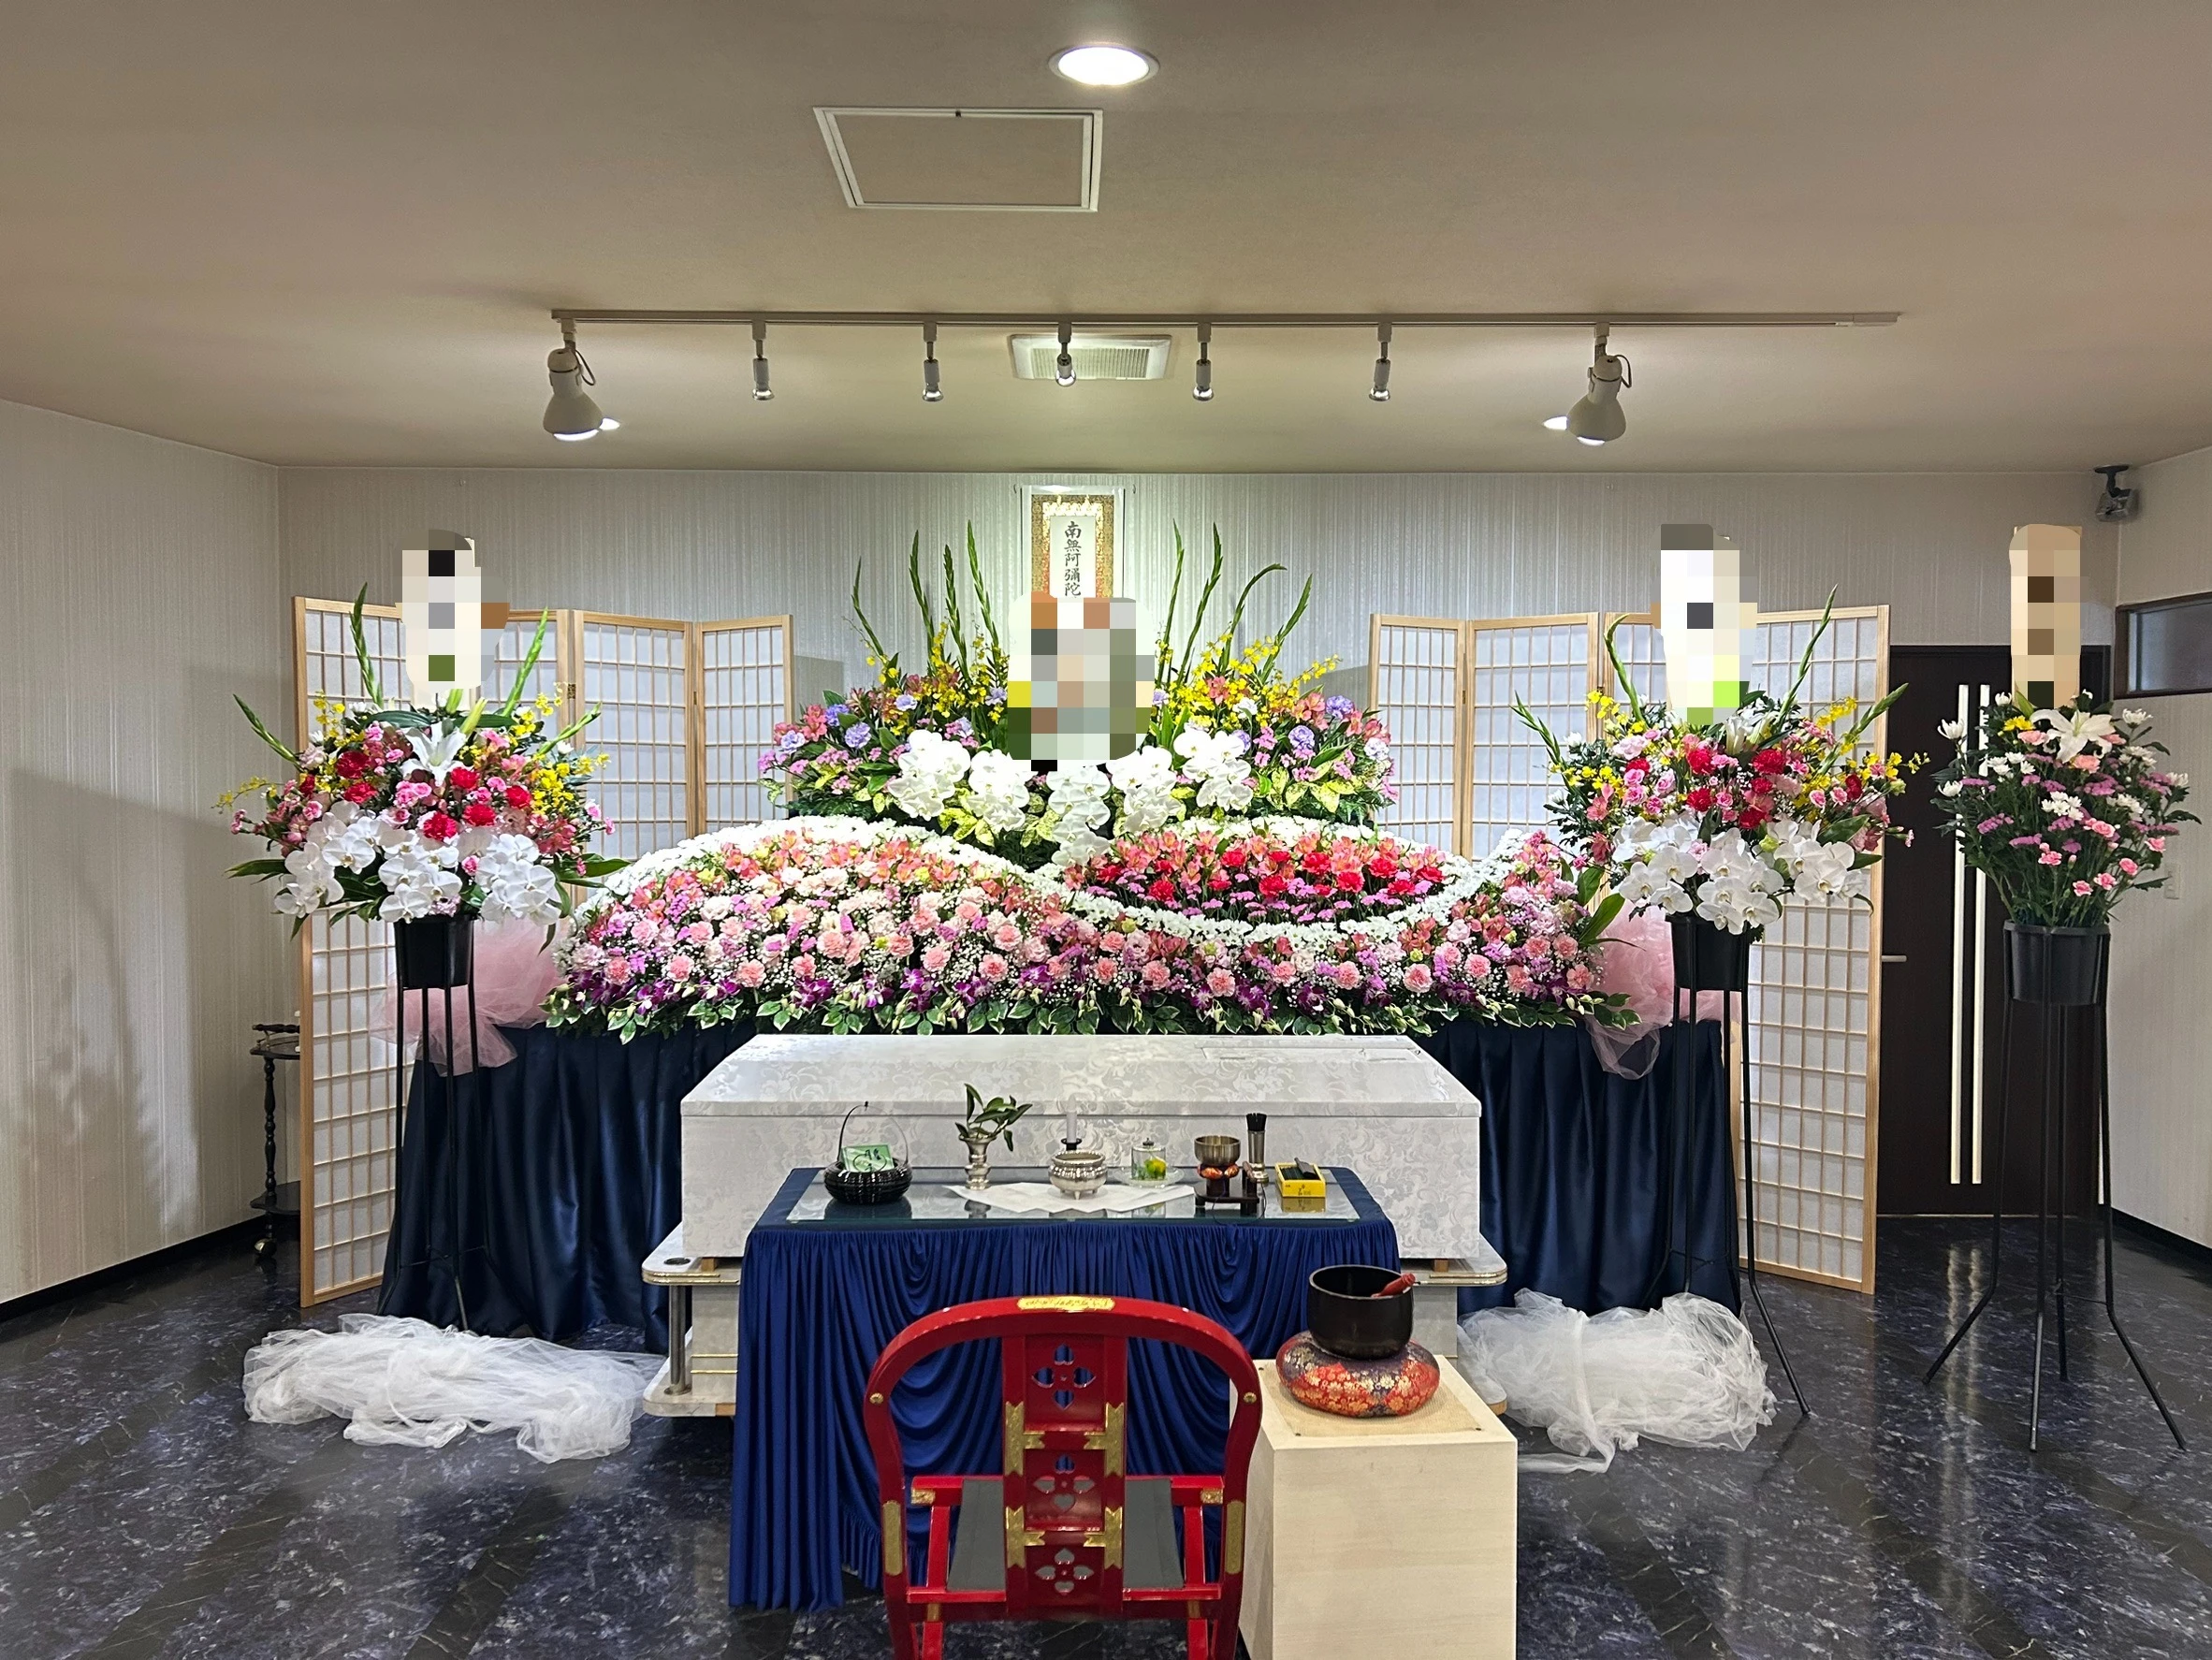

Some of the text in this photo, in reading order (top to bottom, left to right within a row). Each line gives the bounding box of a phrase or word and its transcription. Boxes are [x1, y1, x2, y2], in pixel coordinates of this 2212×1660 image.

[1064, 520, 1082, 598] 南無阿彌陀
